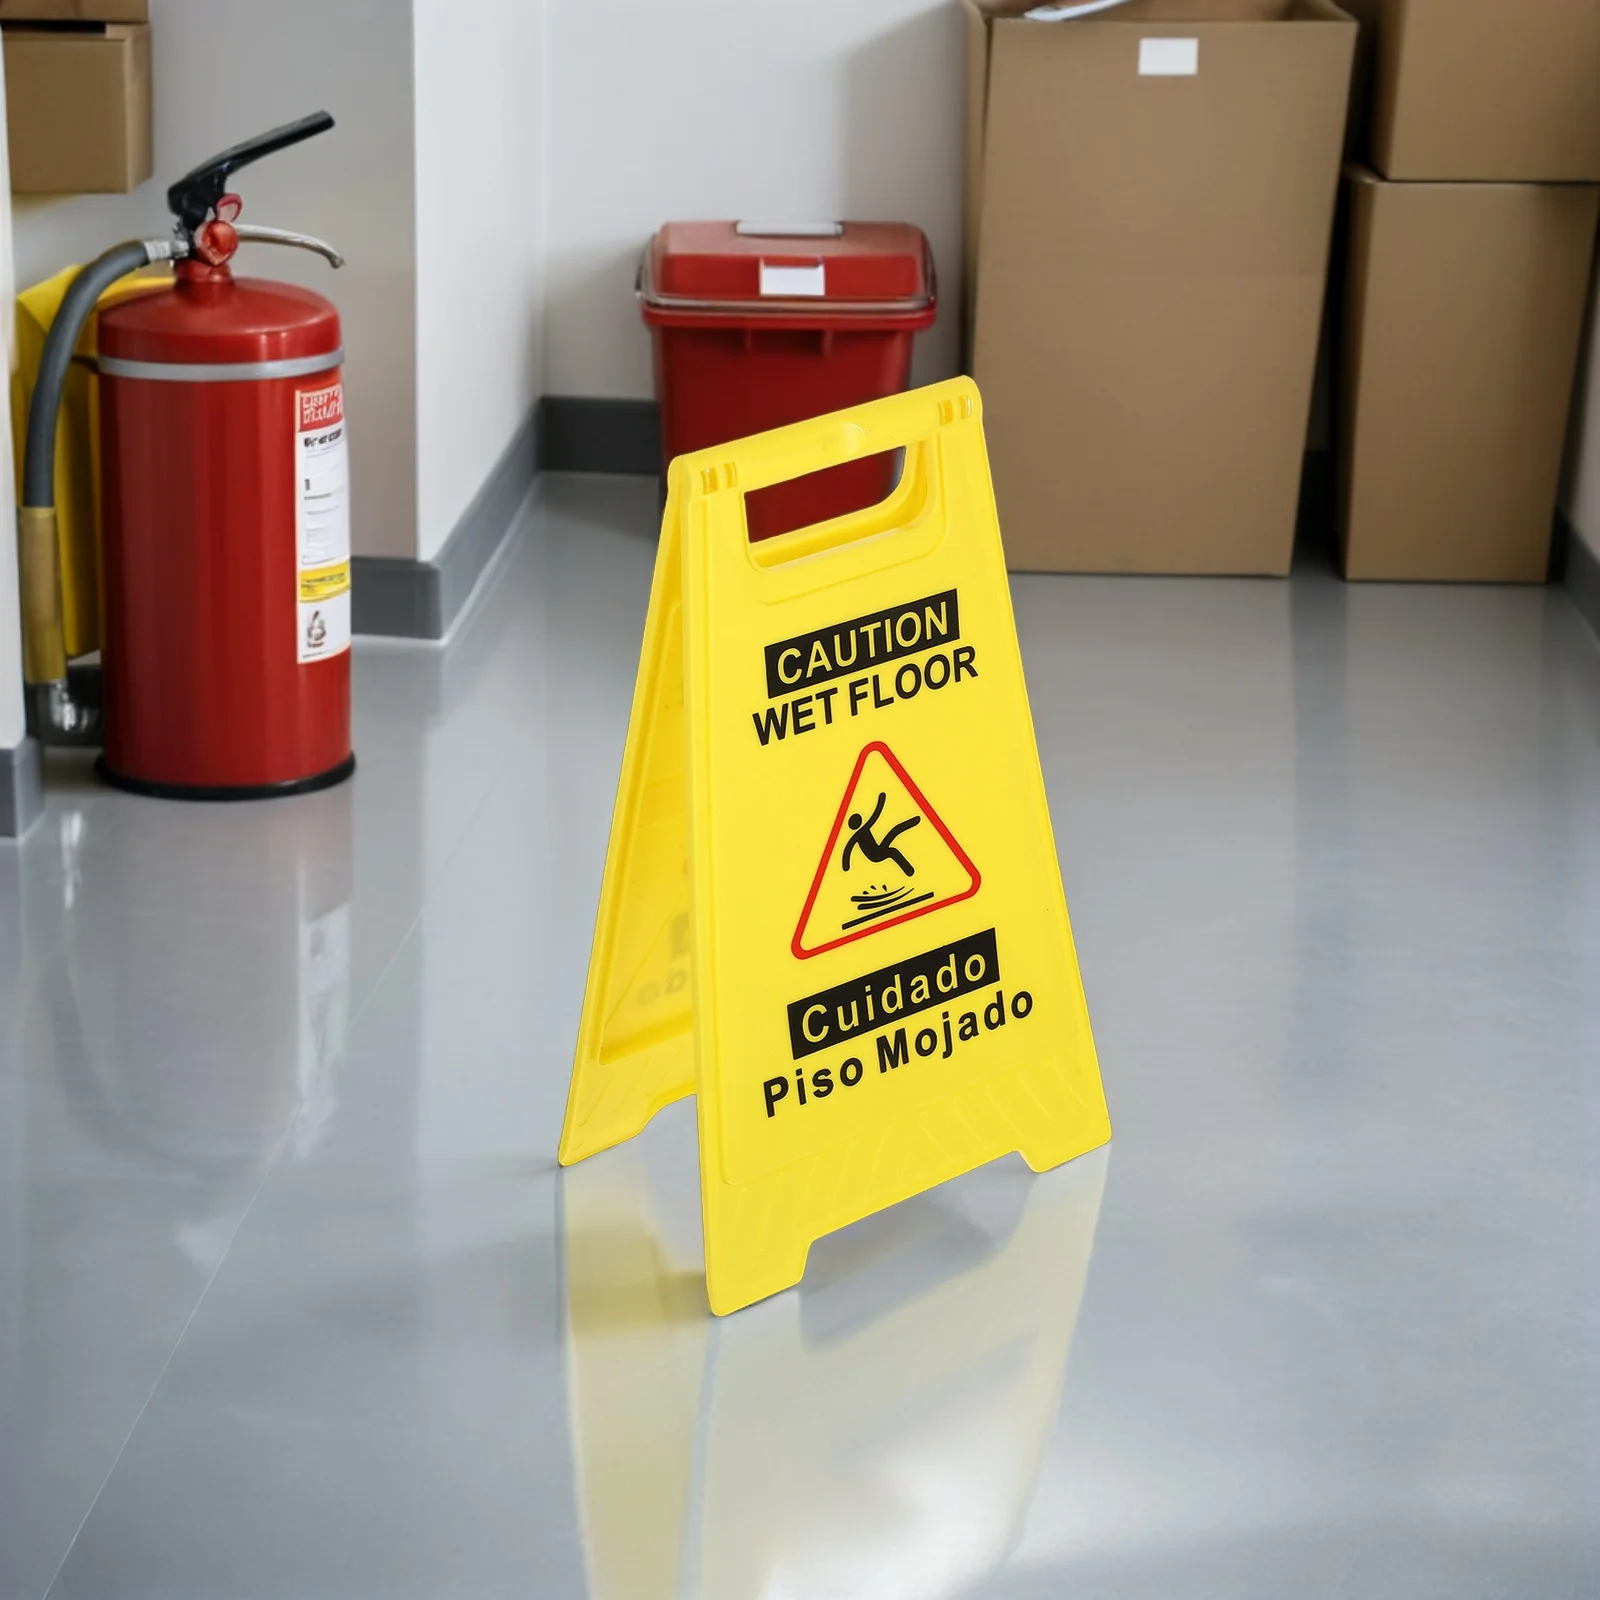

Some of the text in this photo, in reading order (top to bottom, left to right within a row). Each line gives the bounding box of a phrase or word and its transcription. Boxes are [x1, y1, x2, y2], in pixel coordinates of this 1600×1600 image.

[777, 601, 948, 685] CAUTION
[752, 645, 979, 746] WET FLOOR
[802, 953, 986, 1043] Cuidado
[763, 990, 1033, 1118] Piso Mojado
